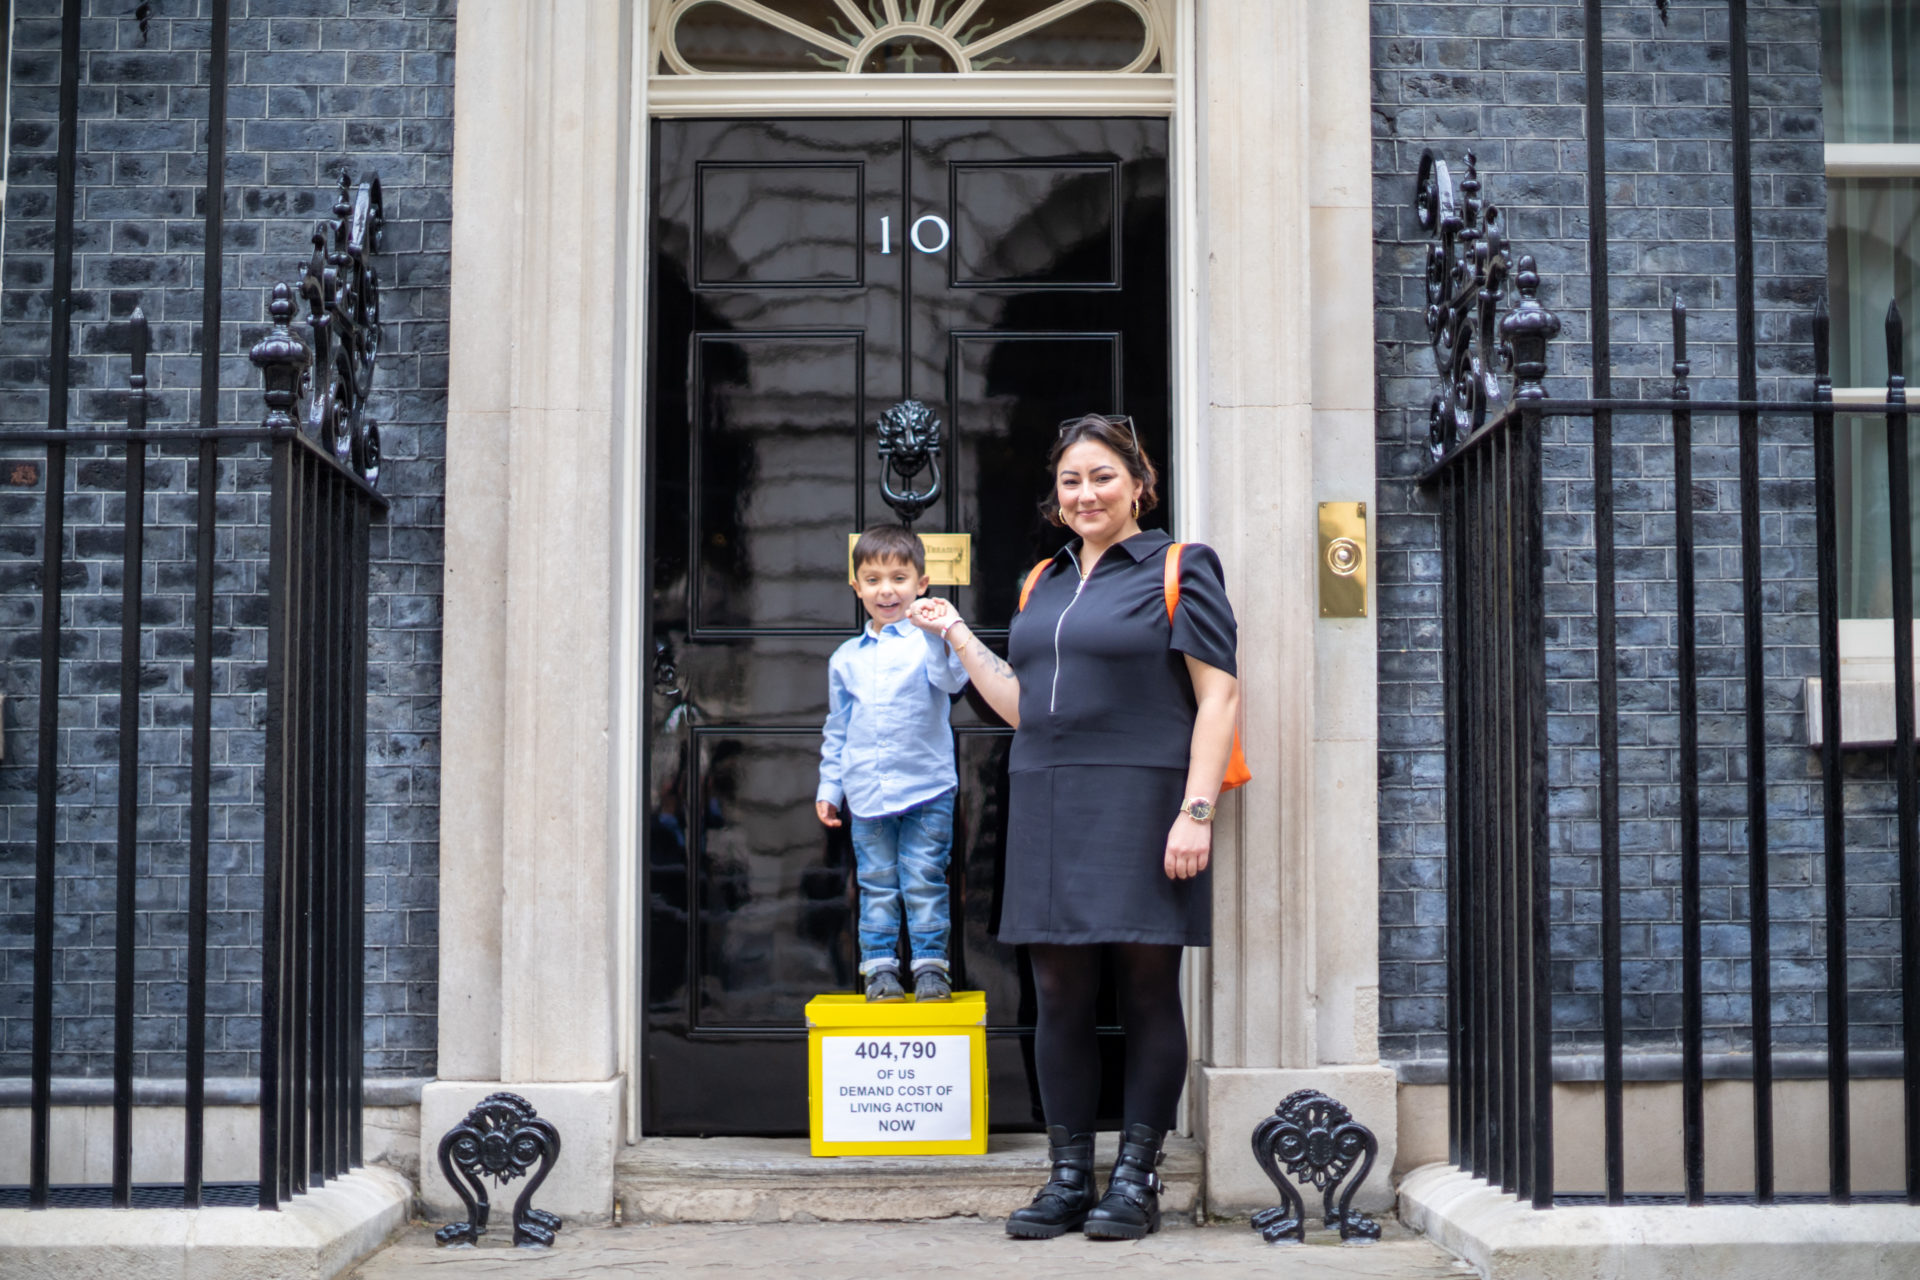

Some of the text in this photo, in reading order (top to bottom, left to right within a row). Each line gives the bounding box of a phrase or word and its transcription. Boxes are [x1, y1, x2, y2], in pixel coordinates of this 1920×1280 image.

[880, 215, 950, 254] 10
[854, 1041, 936, 1061] 404,790
[877, 1069, 915, 1079] OF US
[839, 1085, 953, 1097] DEMAND COST OF
[850, 1102, 943, 1113] LIVING ACTION
[878, 1120, 915, 1131] NOW
